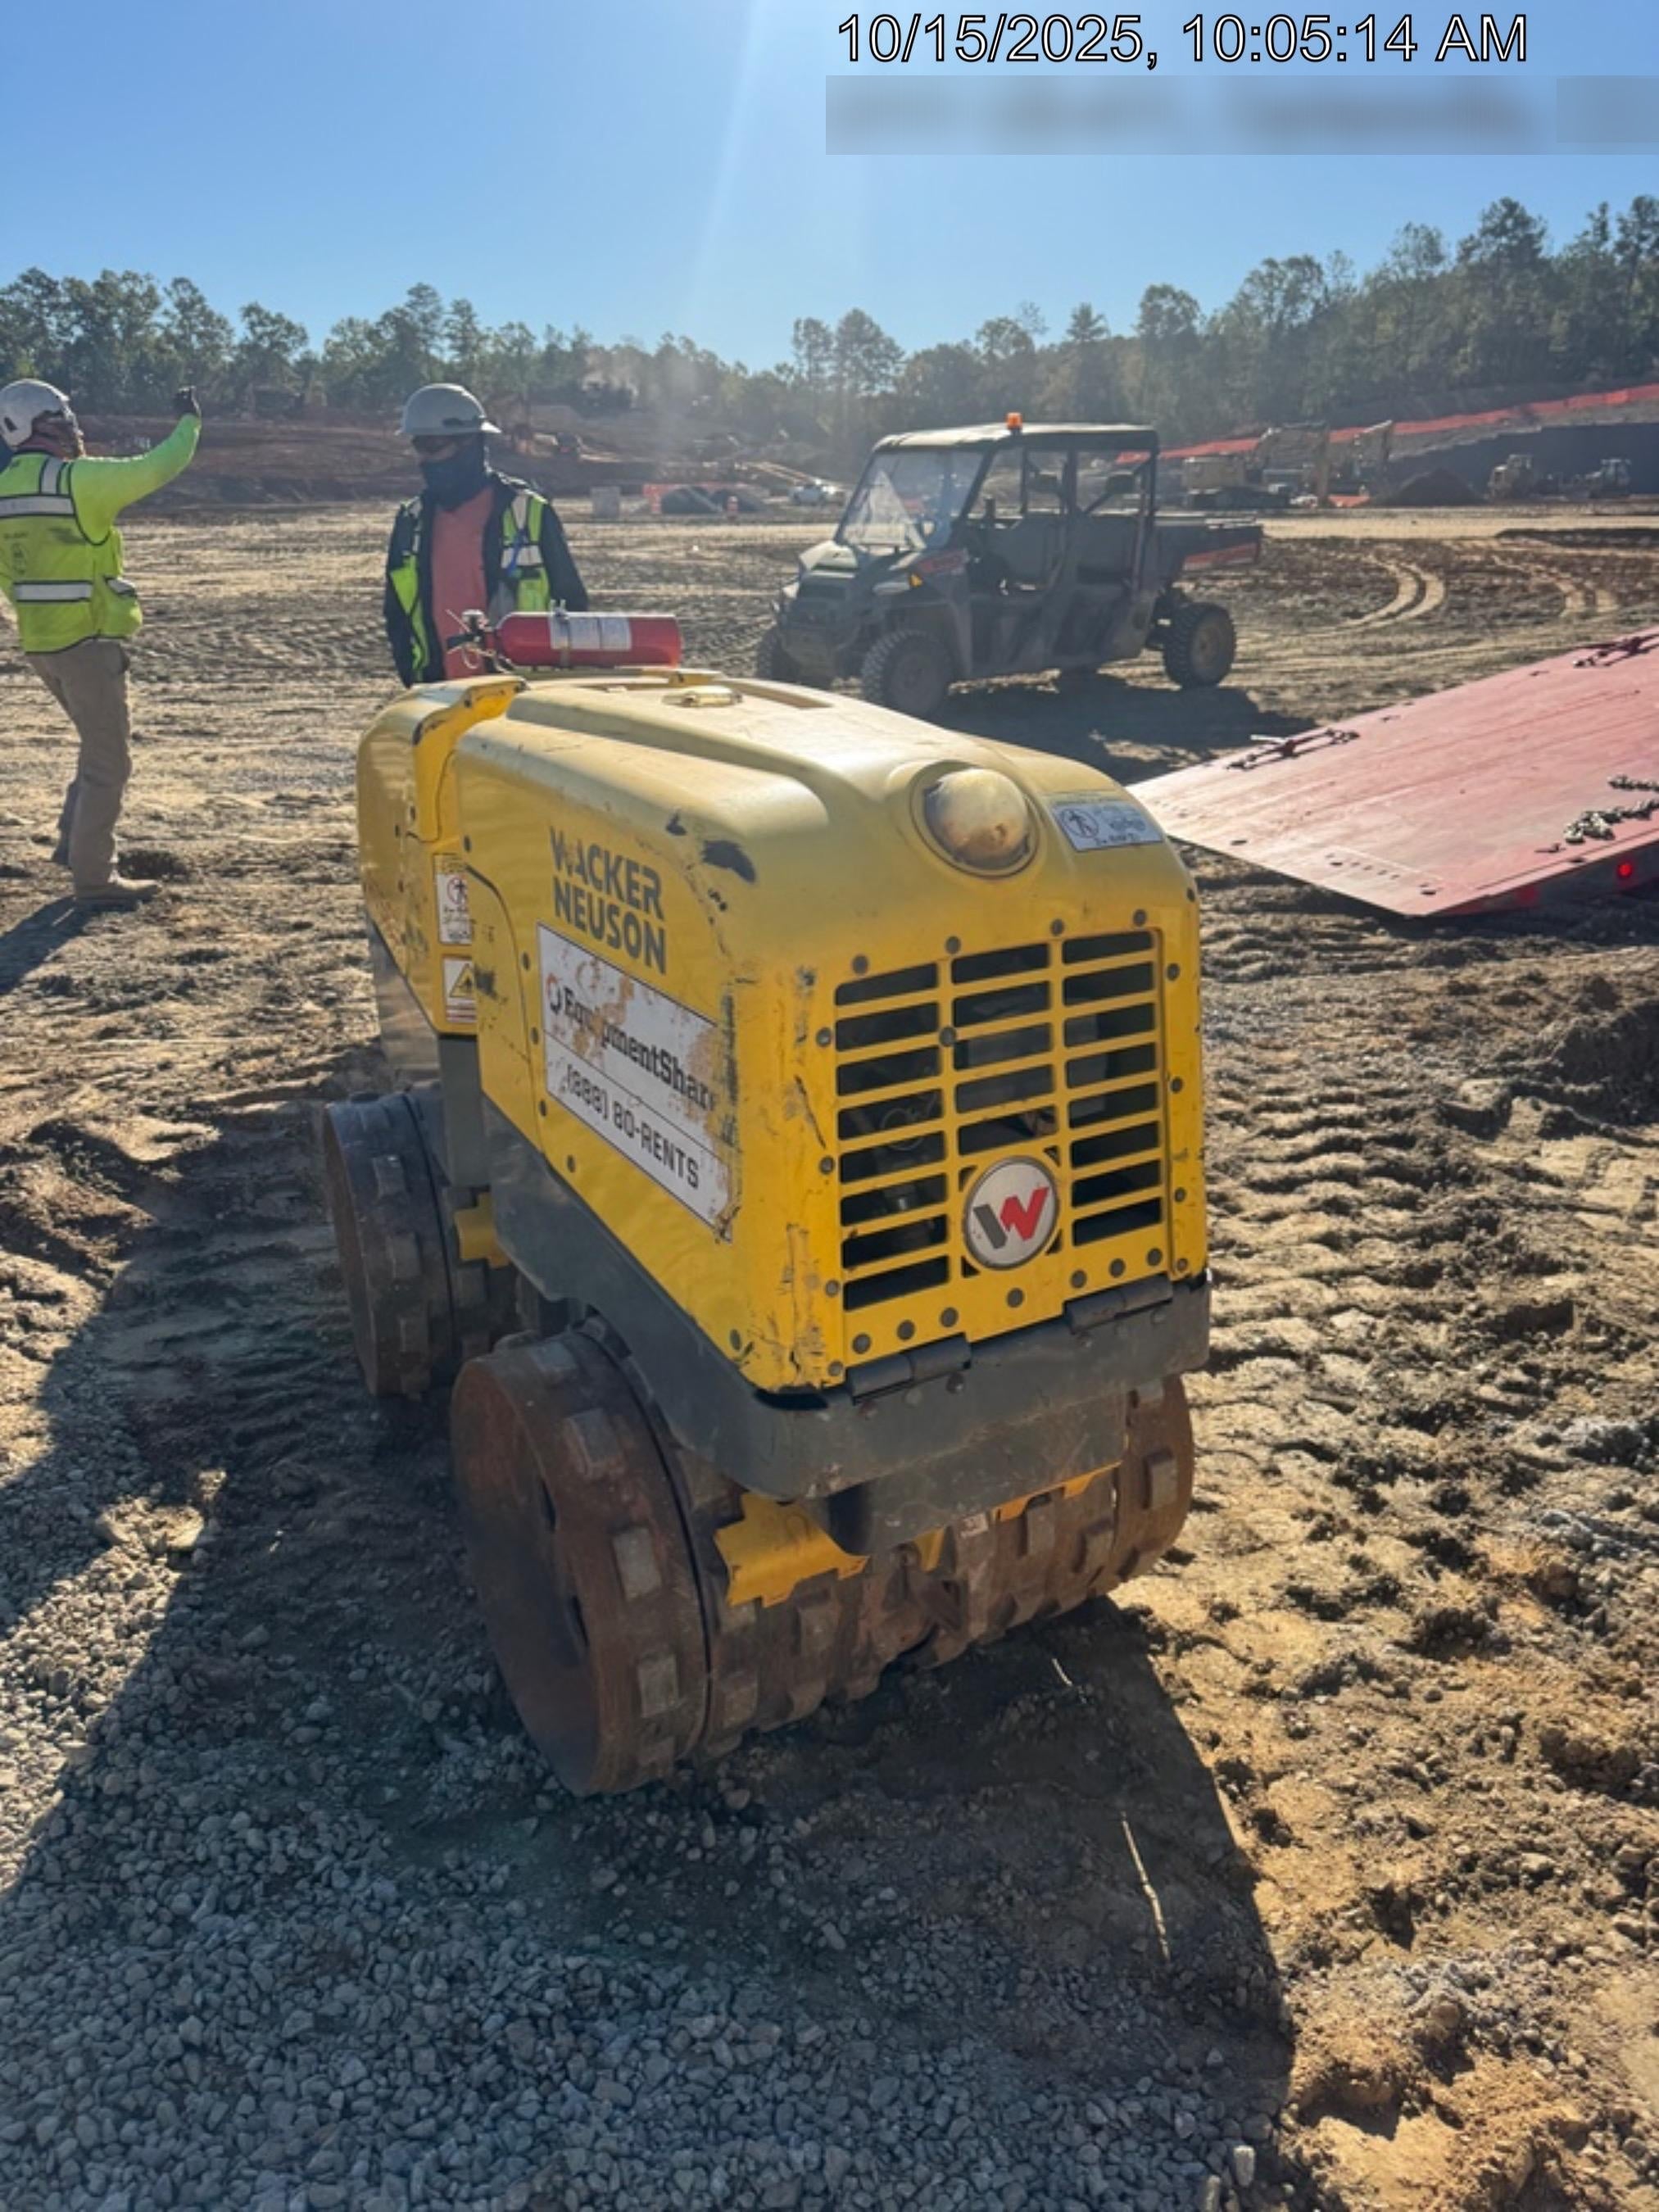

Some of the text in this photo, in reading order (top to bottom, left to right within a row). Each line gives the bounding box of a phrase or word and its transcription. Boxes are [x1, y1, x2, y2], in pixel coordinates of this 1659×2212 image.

[551, 826, 664, 921] WACKER
[553, 876, 666, 975] NEUSON
[564, 986, 715, 1112] EqupmentShar
[566, 1064, 699, 1189] (888) 80-RENTS
